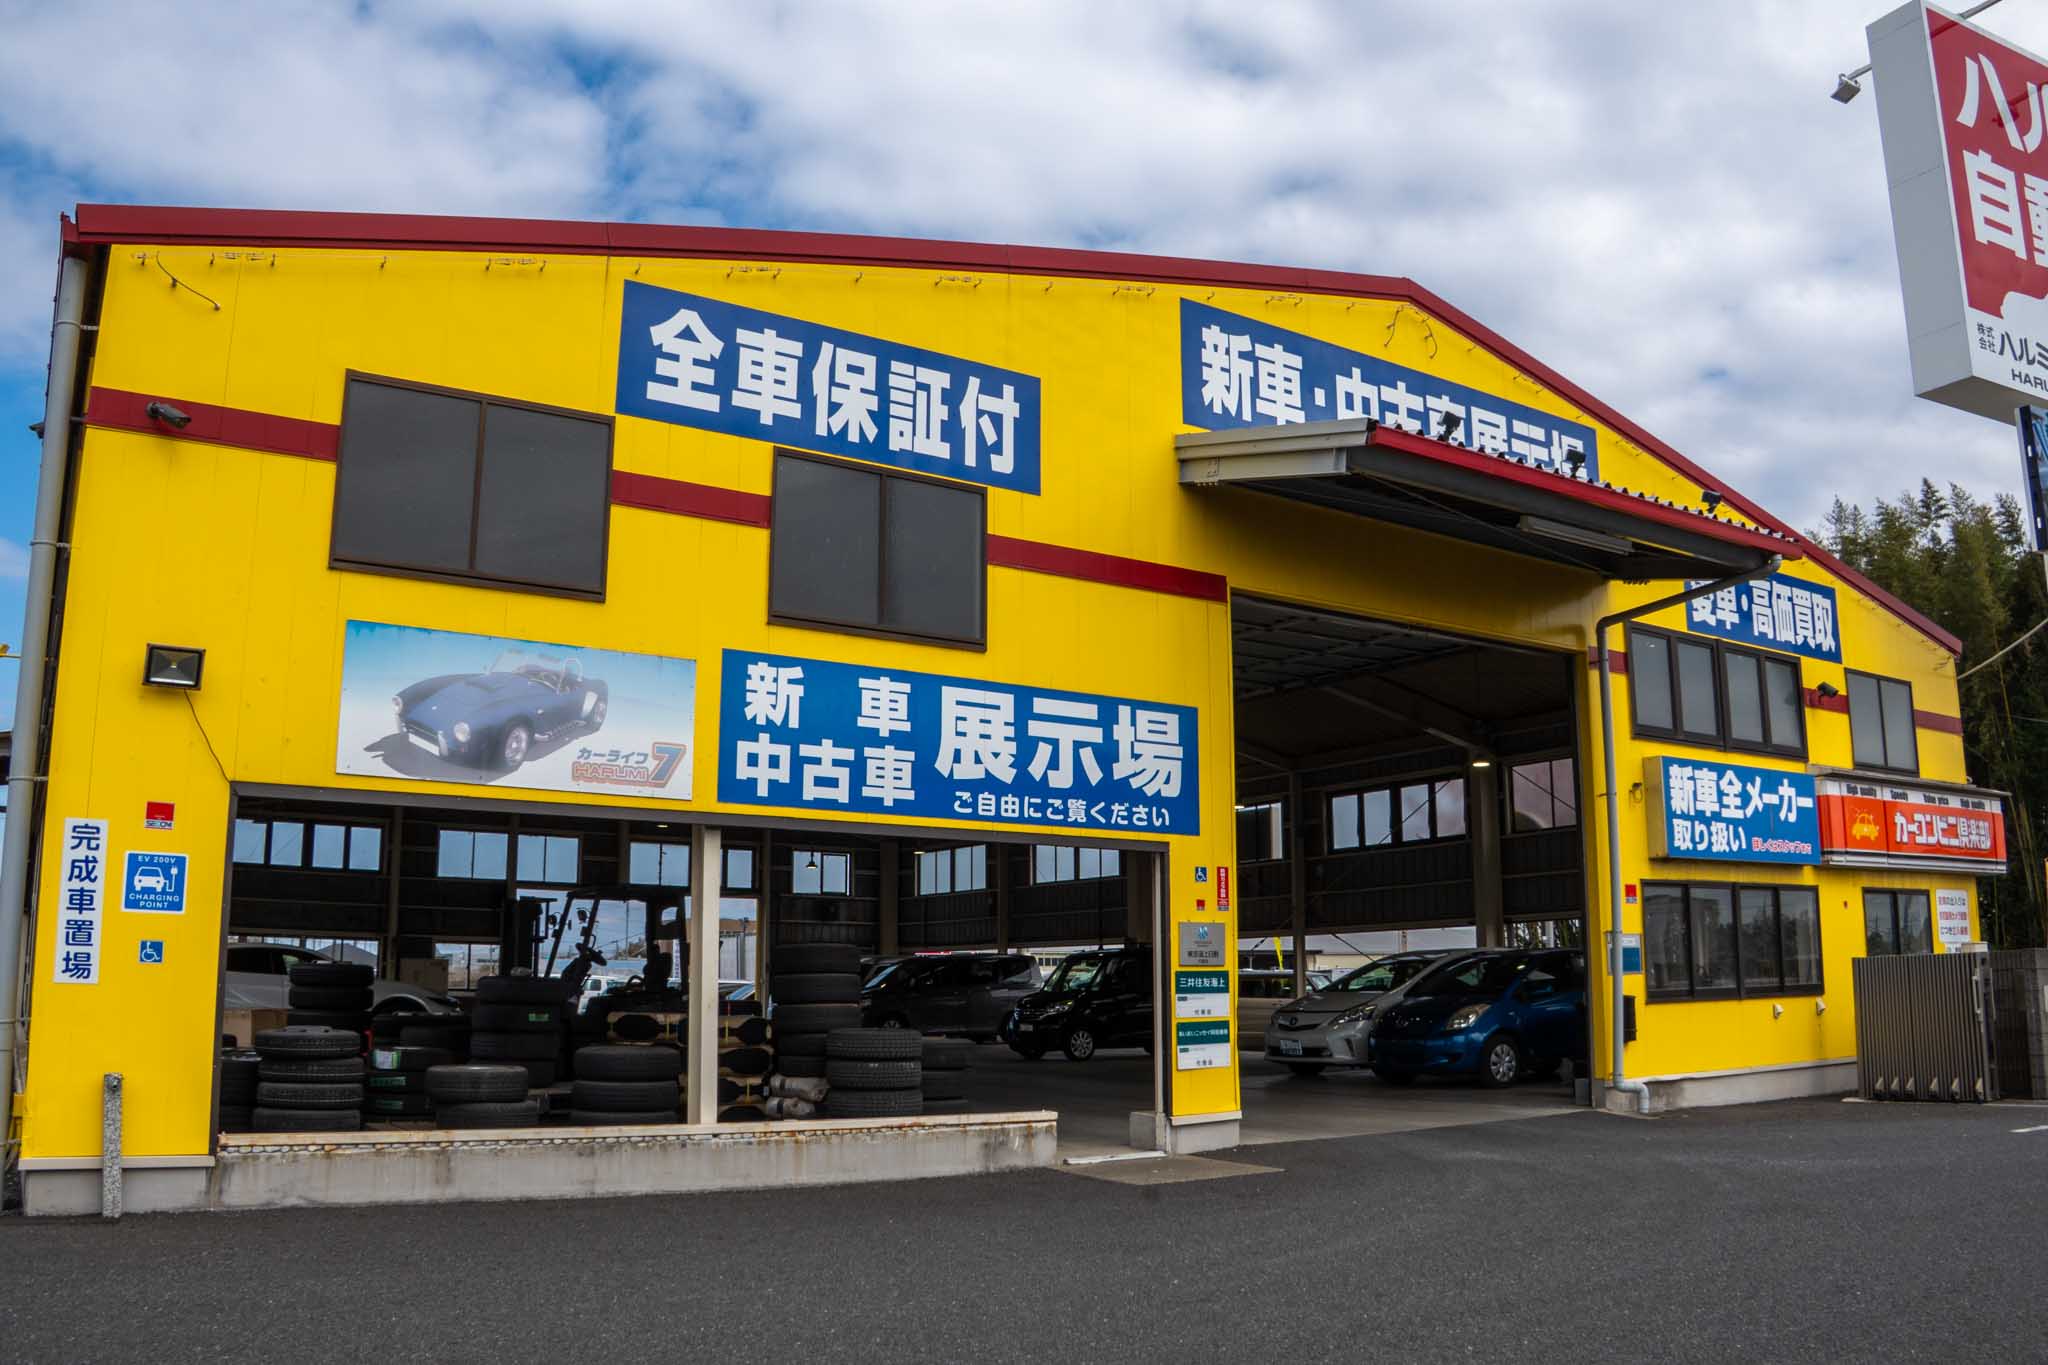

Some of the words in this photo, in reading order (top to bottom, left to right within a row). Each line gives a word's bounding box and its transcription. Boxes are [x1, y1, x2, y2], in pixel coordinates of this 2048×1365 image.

[646, 308, 1020, 474] 全車保証付
[577, 747, 649, 764] カーライフ
[651, 742, 687, 788] 7
[934, 685, 1184, 798] 展示場
[574, 763, 648, 782] HARUMI
[735, 733, 916, 807] 中古車
[1669, 764, 1813, 823] 新車全メーカー
[953, 791, 1170, 828] ご自由にご覧ください
[1672, 818, 1747, 852] 取り扱い
[61, 823, 101, 980] 完成車置場
[129, 893, 179, 902] CHARGING
